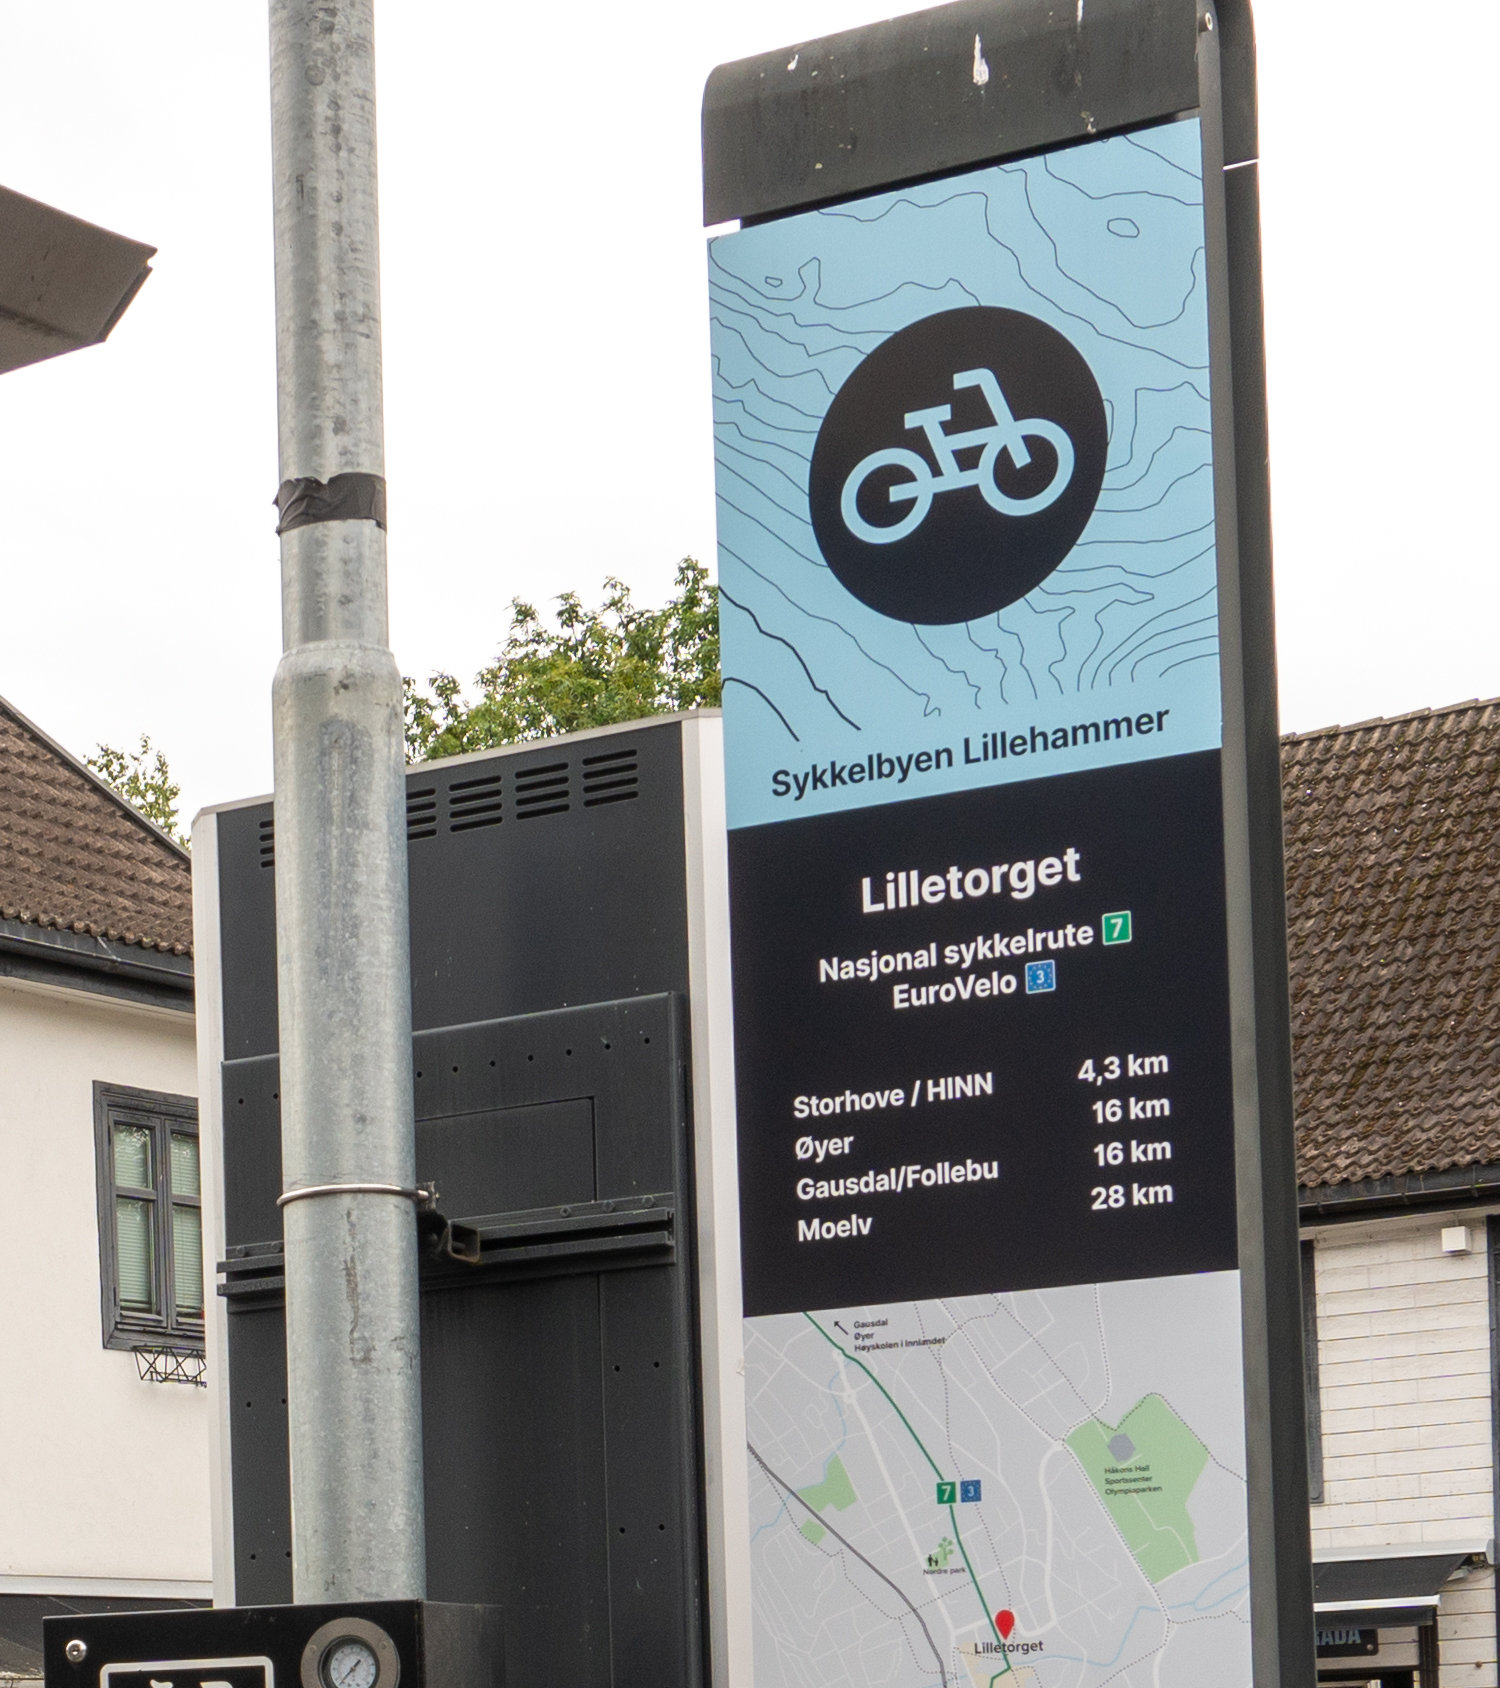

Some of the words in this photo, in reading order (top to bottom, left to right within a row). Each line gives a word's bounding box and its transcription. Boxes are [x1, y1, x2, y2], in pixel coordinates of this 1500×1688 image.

[771, 746, 954, 802] Sykkelbyen
[963, 708, 1170, 765] Lillehammer
[861, 847, 1081, 914] Lilletorget
[819, 943, 937, 984] Nasjonal
[944, 924, 1094, 965] sykkelrute
[1110, 918, 1124, 939] 7
[893, 972, 1017, 1009] EuroVelo
[1077, 1056, 1121, 1087] 4,3
[1127, 1053, 1169, 1076] km
[793, 1088, 905, 1119] Storhove
[911, 1081, 921, 1107] /
[927, 1072, 994, 1103] HINN
[1092, 1101, 1122, 1124] 16
[1130, 1097, 1170, 1119] km
[796, 1134, 854, 1165] Øyer
[1094, 1144, 1124, 1167] 16
[1131, 1139, 1172, 1162] km
[797, 1160, 999, 1200] Gausdal/Follebu
[1090, 1187, 1125, 1211] 28
[1132, 1182, 1173, 1205] km
[798, 1215, 873, 1242] Moelv
[853, 1318, 889, 1329] Gausdal
[854, 1332, 875, 1341] Øyer
[941, 1485, 951, 1501] 7
[923, 1568, 948, 1576] Nordre
[950, 1567, 966, 1575] park
[974, 1640, 1044, 1655] Lilletorget
